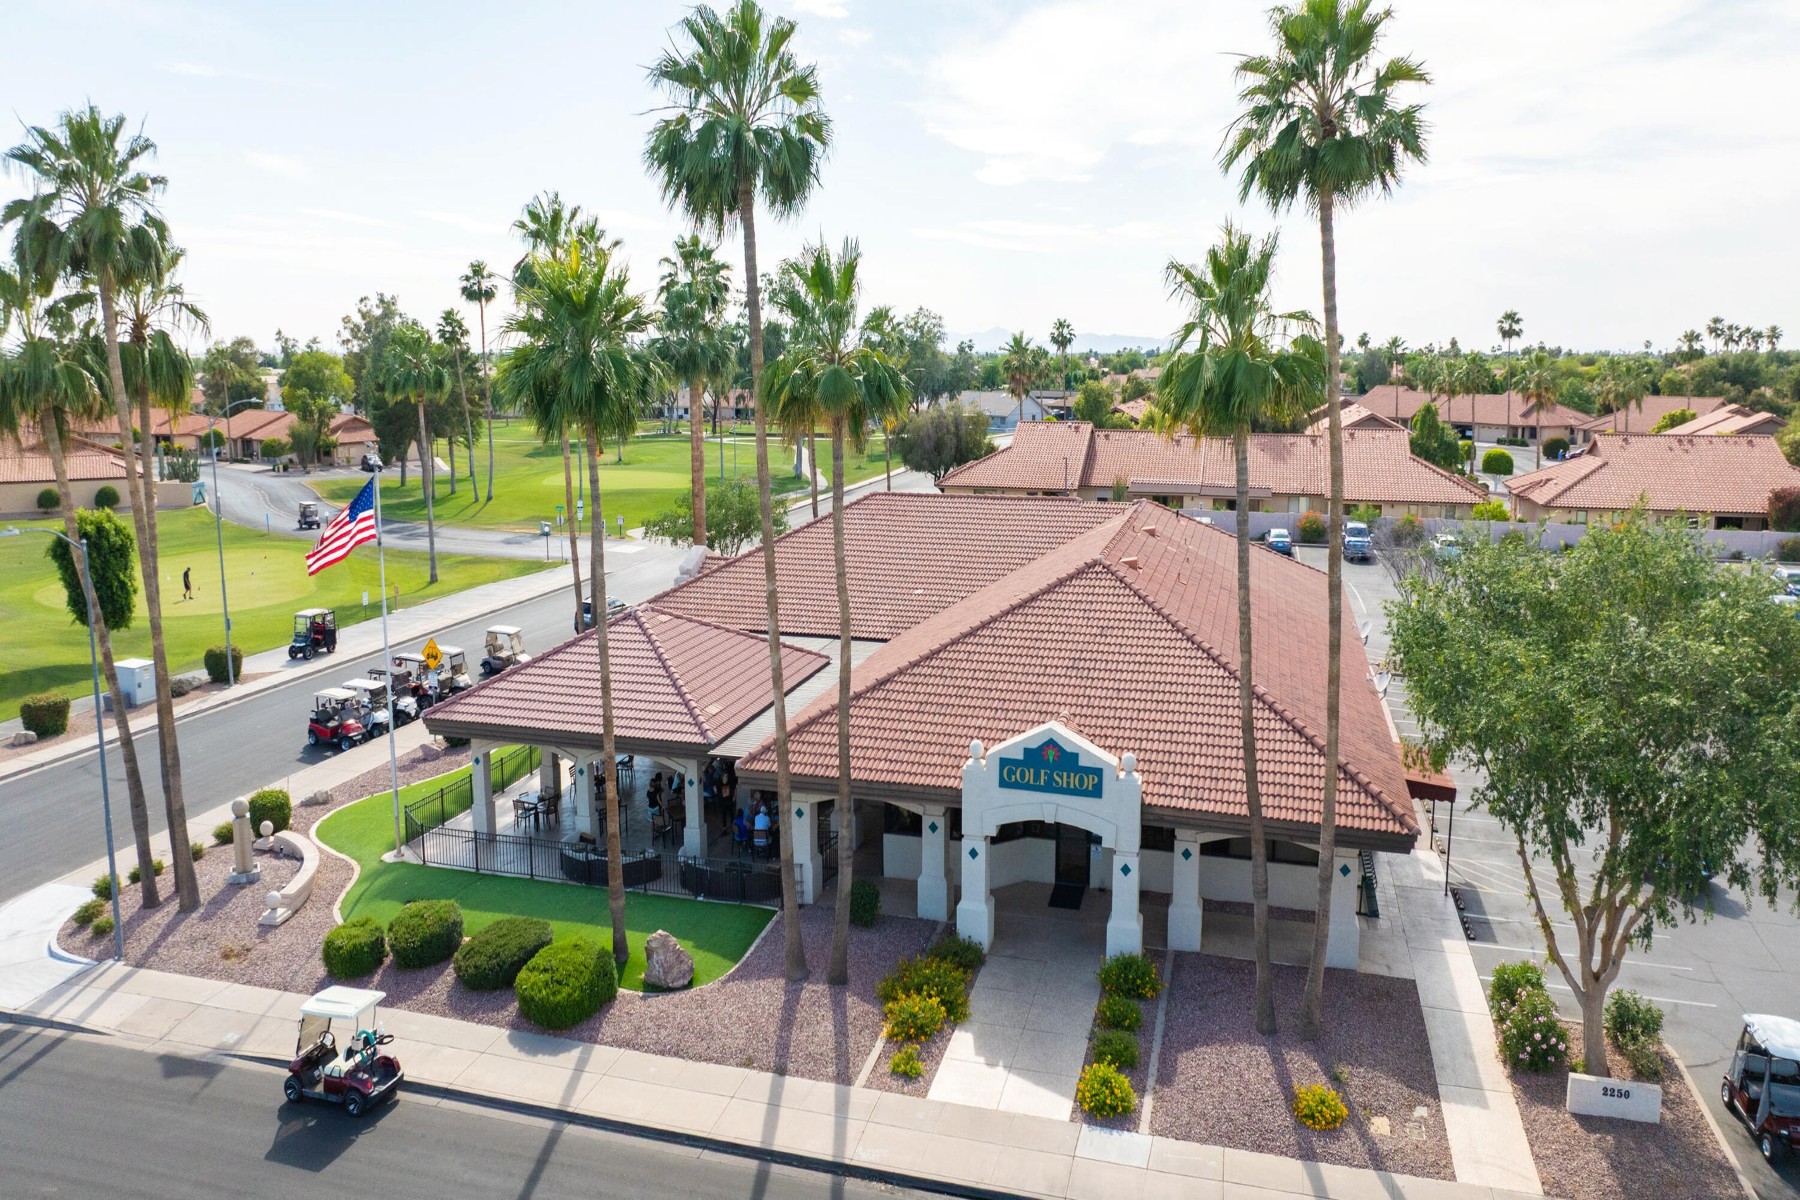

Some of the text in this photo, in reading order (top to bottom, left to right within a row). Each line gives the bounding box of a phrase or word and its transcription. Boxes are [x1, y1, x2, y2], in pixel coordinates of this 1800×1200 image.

[1003, 765, 1098, 791] GOLF SHOP
[1602, 1087, 1630, 1099] 2250
